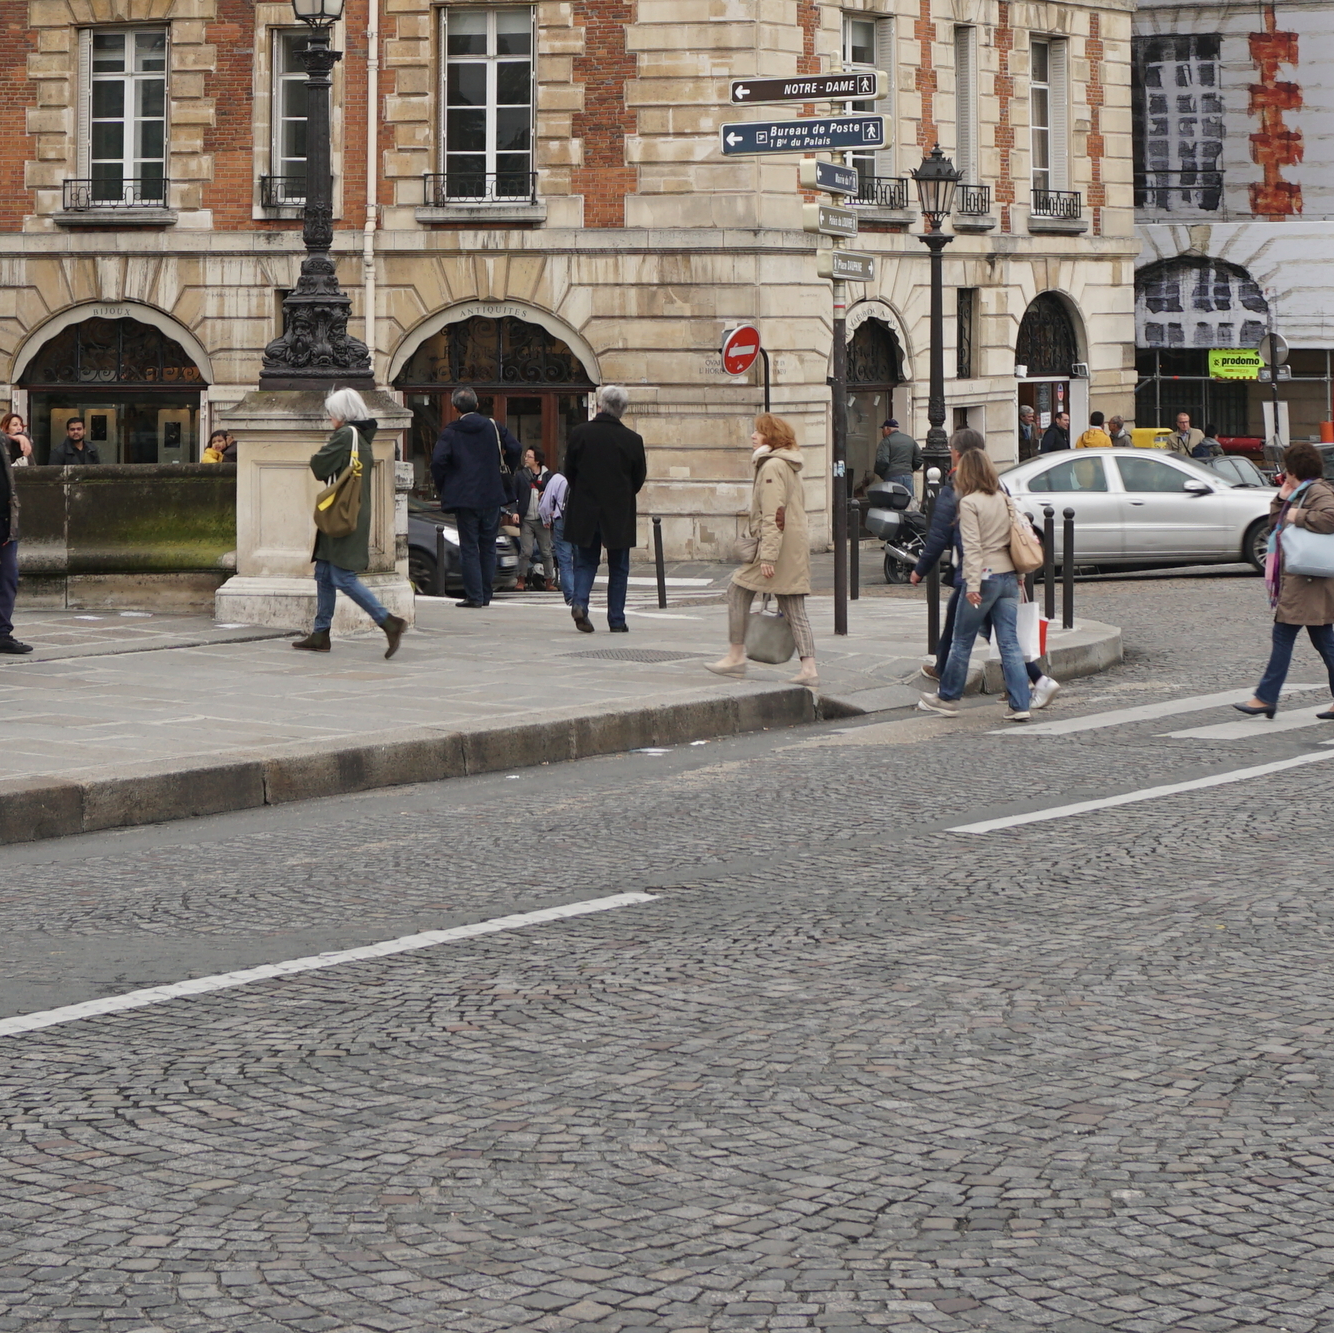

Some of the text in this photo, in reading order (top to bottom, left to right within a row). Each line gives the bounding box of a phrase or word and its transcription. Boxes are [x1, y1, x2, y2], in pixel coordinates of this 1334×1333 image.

[784, 82, 817, 95] NOTRE
[825, 80, 855, 93] DAME
[770, 122, 860, 137] Bureau de Poste
[770, 139, 774, 148] 1
[791, 138, 800, 146] du
[804, 136, 831, 146] Palais
[829, 214, 838, 226] Palais
[93, 307, 131, 316] BIJOUX
[459, 306, 528, 318] ANTIQUITES
[1221, 356, 1260, 367] prodomo
